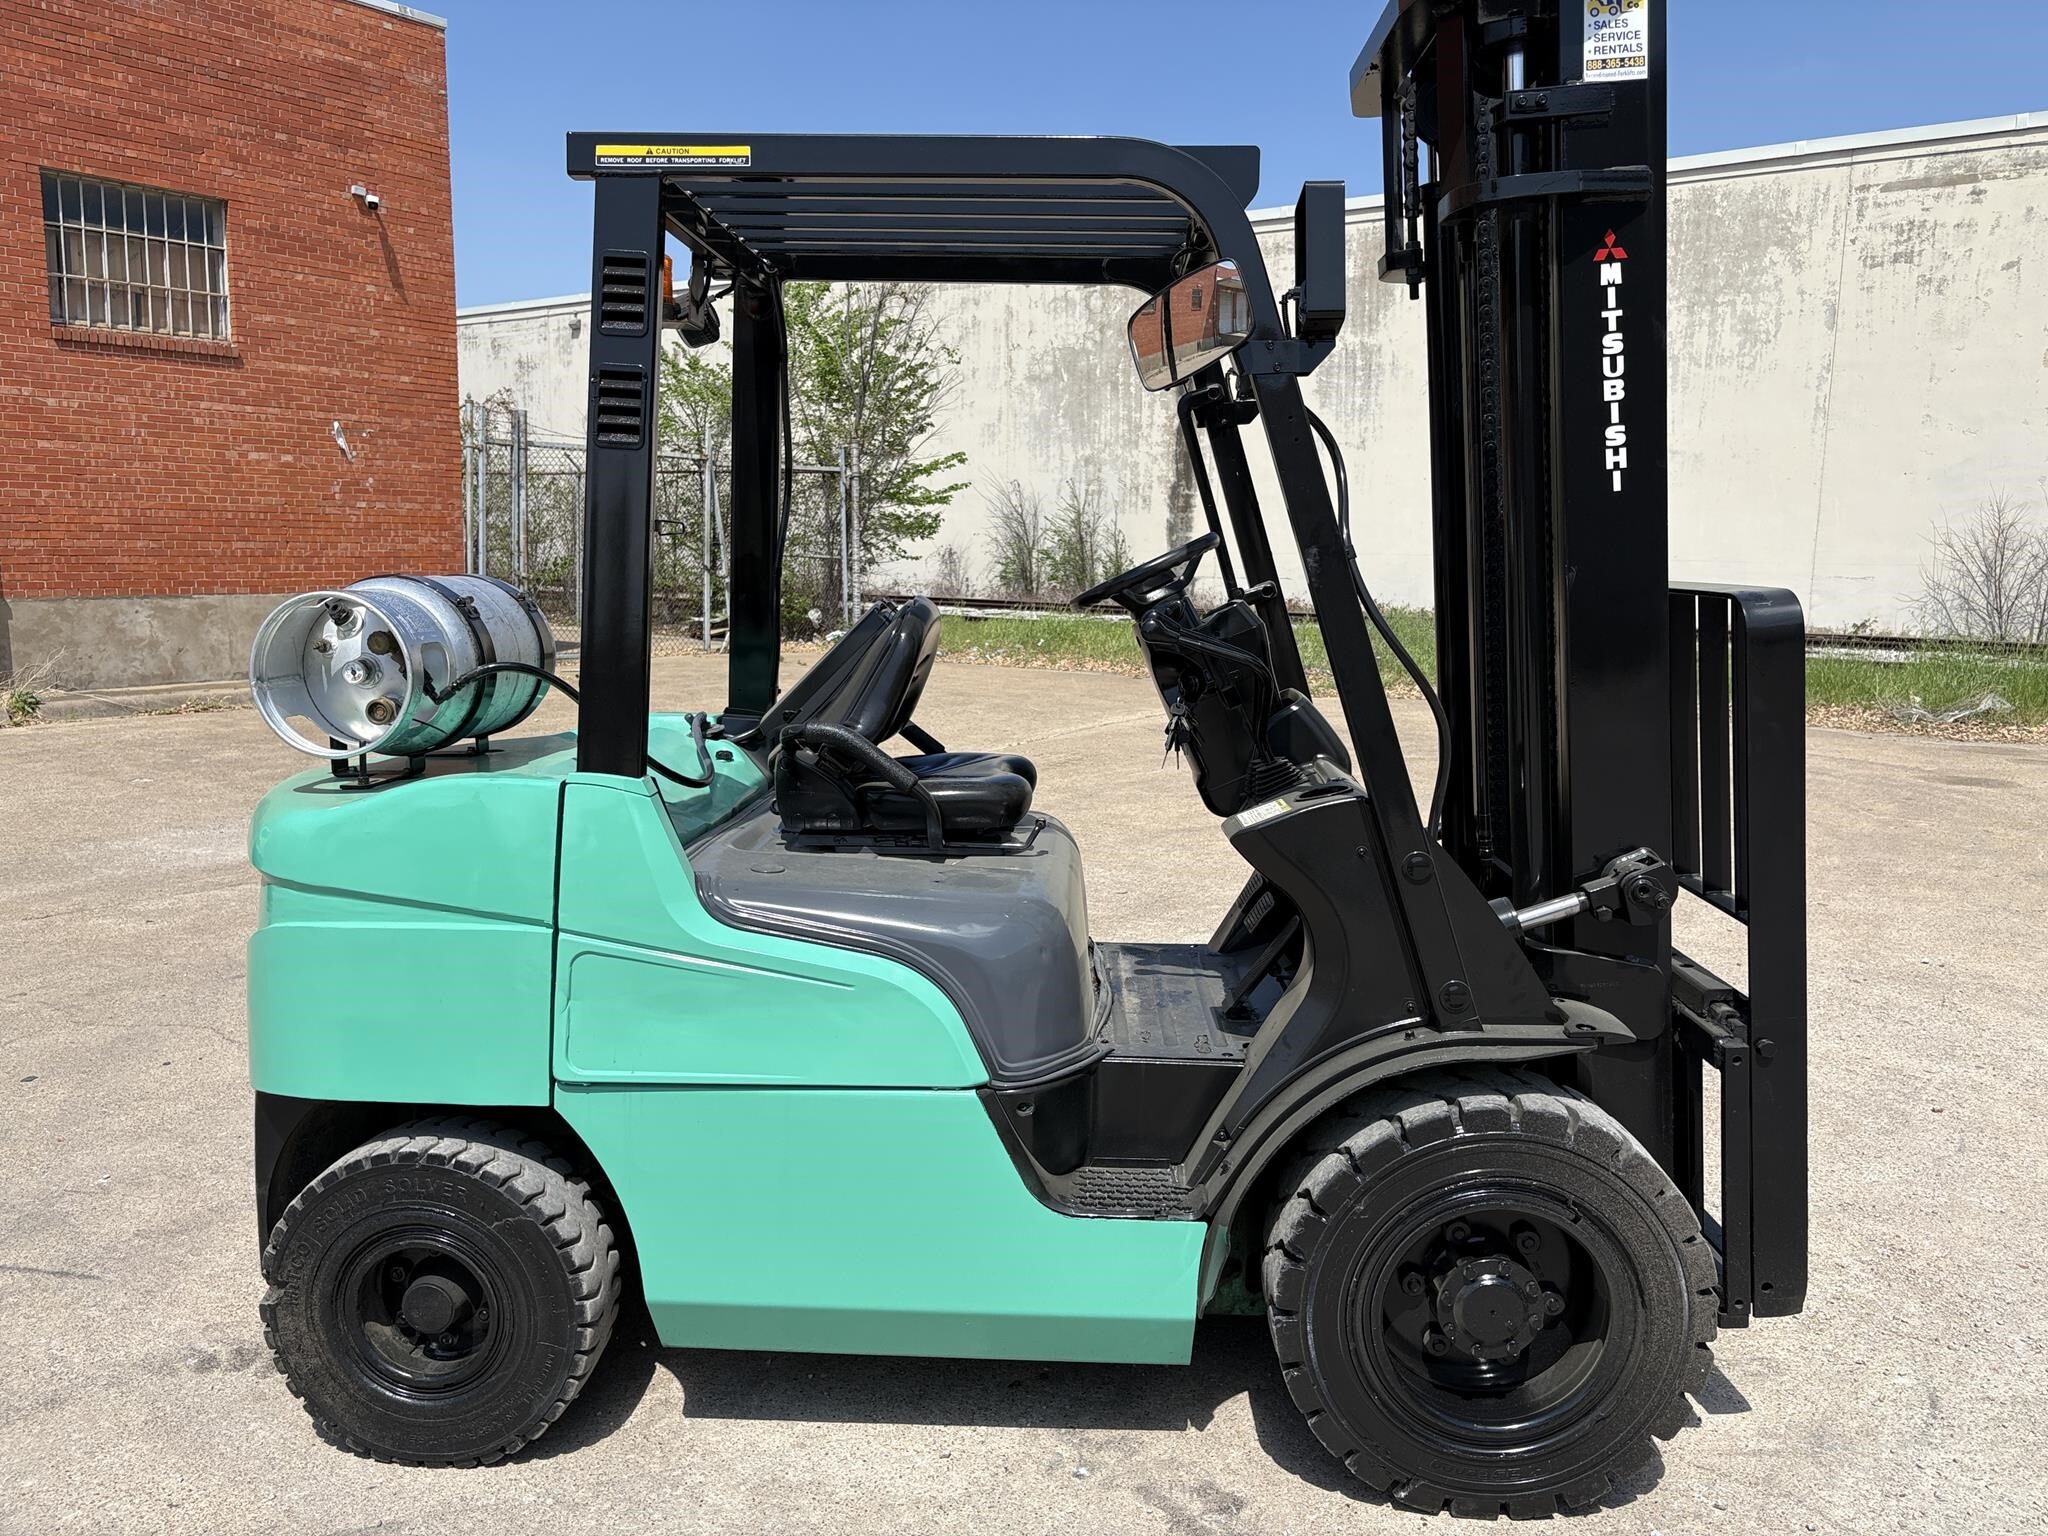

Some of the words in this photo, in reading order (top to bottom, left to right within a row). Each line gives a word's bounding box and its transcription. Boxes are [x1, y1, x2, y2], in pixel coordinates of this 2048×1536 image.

[1627, 1, 1640, 9] Co
[1593, 18, 1629, 30] SALES
[1593, 30, 1641, 43] SERVICE
[1593, 43, 1643, 55] RENTALS
[1587, 56, 1645, 70] 888-365-5438
[1600, 262, 1628, 492] MITSUBISHI
